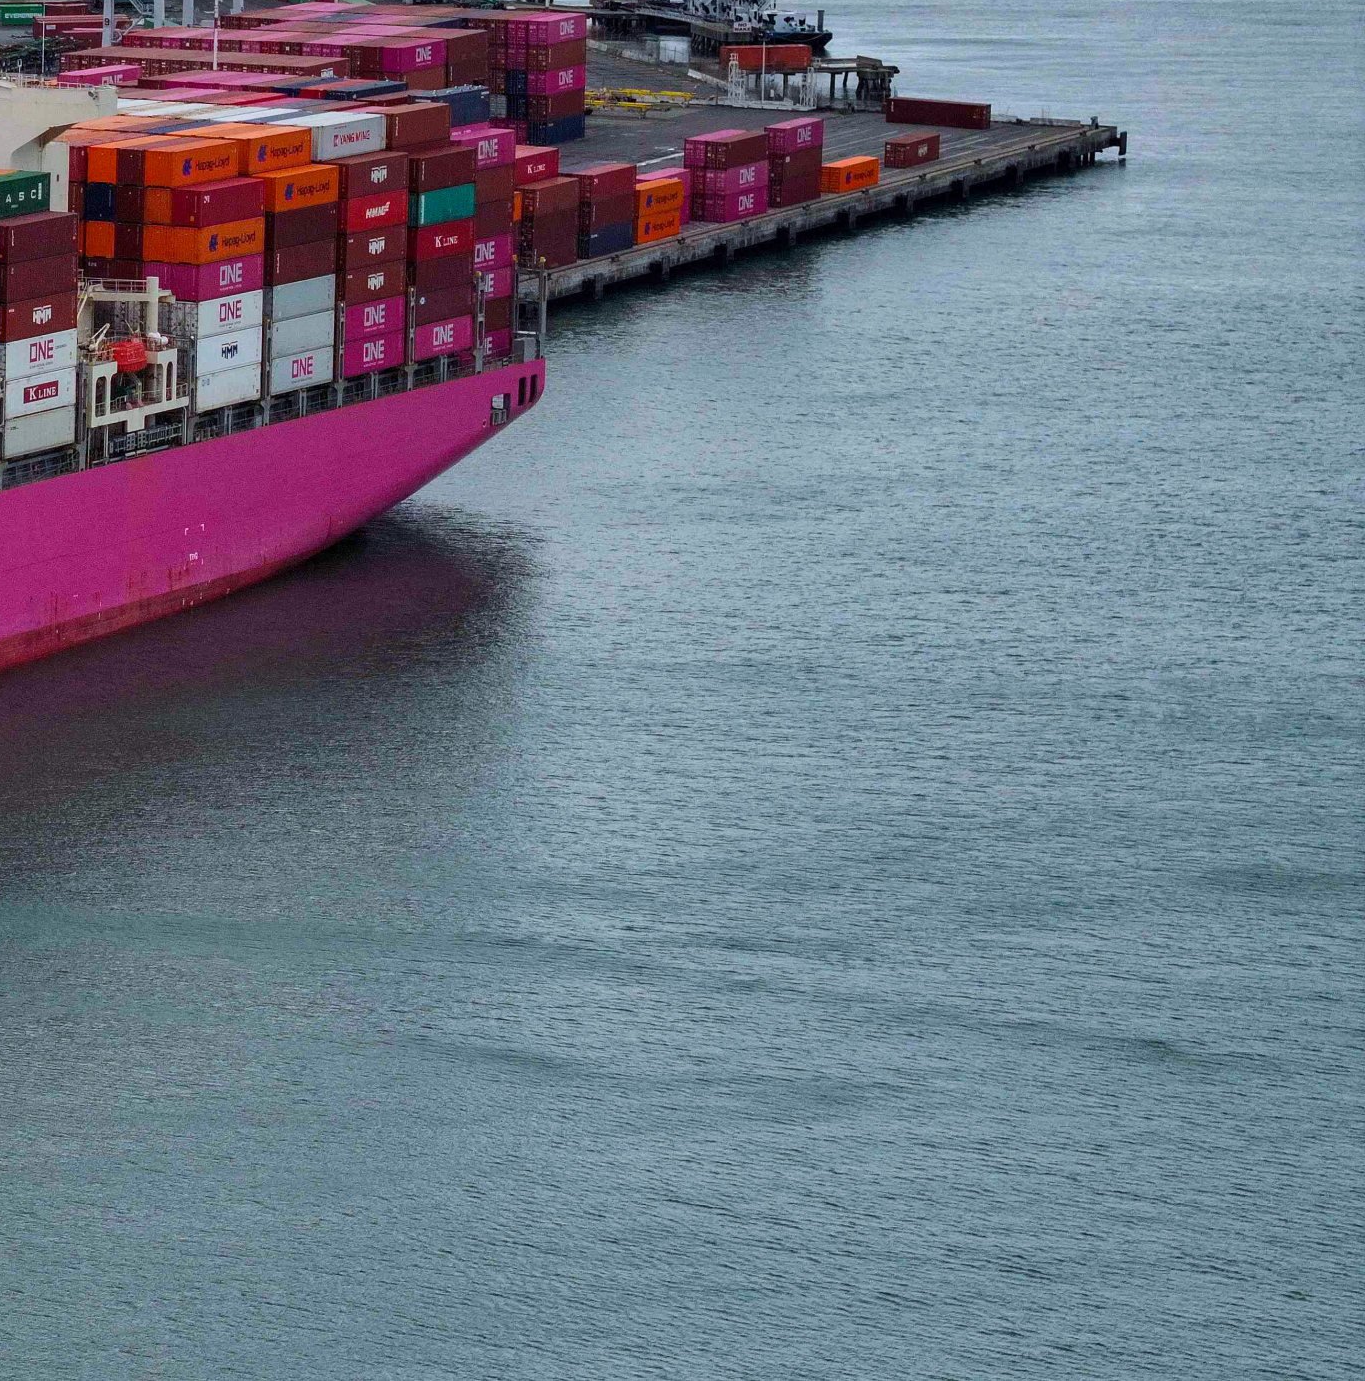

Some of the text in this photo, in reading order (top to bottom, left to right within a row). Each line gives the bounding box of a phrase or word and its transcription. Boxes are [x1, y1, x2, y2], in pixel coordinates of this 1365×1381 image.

[559, 23, 575, 38] ONE
[416, 47, 433, 61] ONE
[559, 69, 575, 85] ONE
[798, 126, 811, 143] ONE
[478, 138, 499, 160] ONE
[740, 167, 755, 185] ONE
[739, 193, 754, 212] ONE
[435, 234, 458, 248] K LINE
[475, 241, 496, 263] ONE
[219, 262, 243, 286] ONE
[33, 305, 52, 325] HMM
[219, 299, 242, 323] ONE
[364, 303, 386, 327] ONE
[433, 323, 454, 346] ONE
[29, 338, 54, 364] ONE
[221, 341, 238, 360] HMM
[363, 339, 384, 362] ONE
[291, 356, 313, 378] ONE
[29, 385, 57, 399] K LINE
